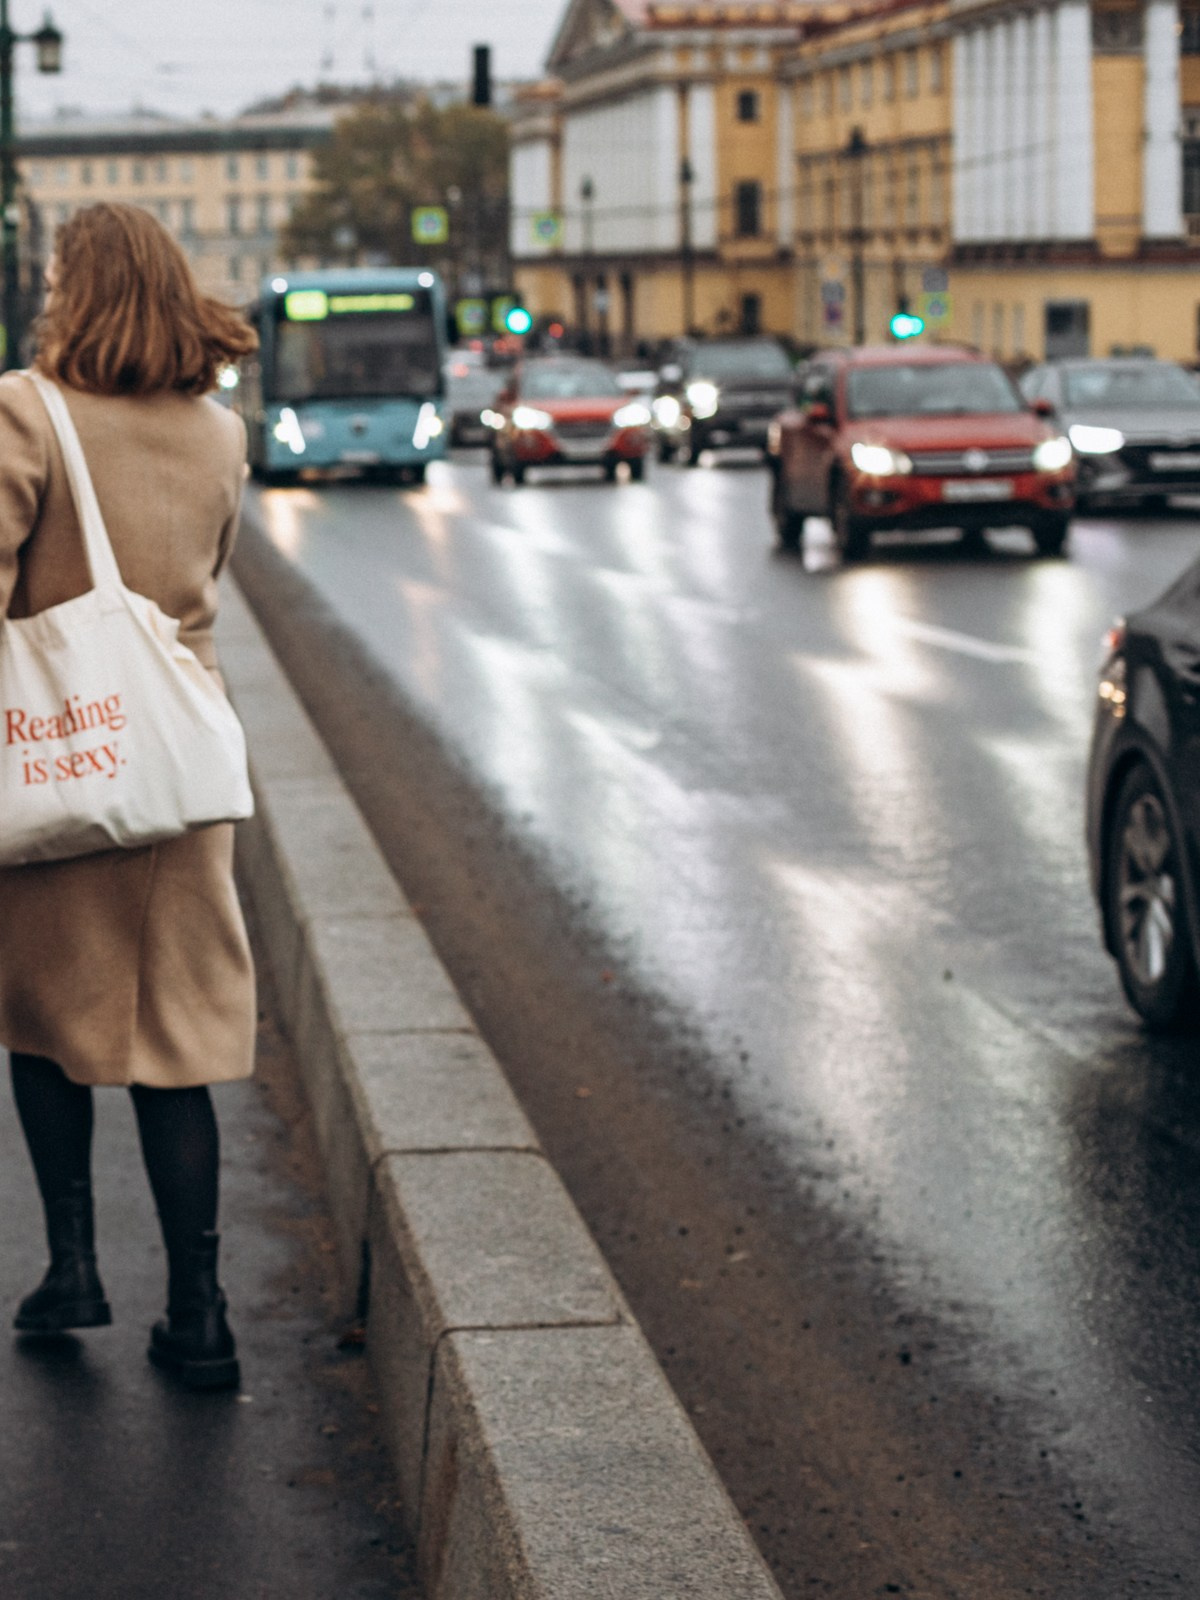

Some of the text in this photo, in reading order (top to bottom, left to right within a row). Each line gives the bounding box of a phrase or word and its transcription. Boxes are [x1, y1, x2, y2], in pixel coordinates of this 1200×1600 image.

[4, 693, 126, 746] Reading
[22, 741, 127, 785] is sexy.
